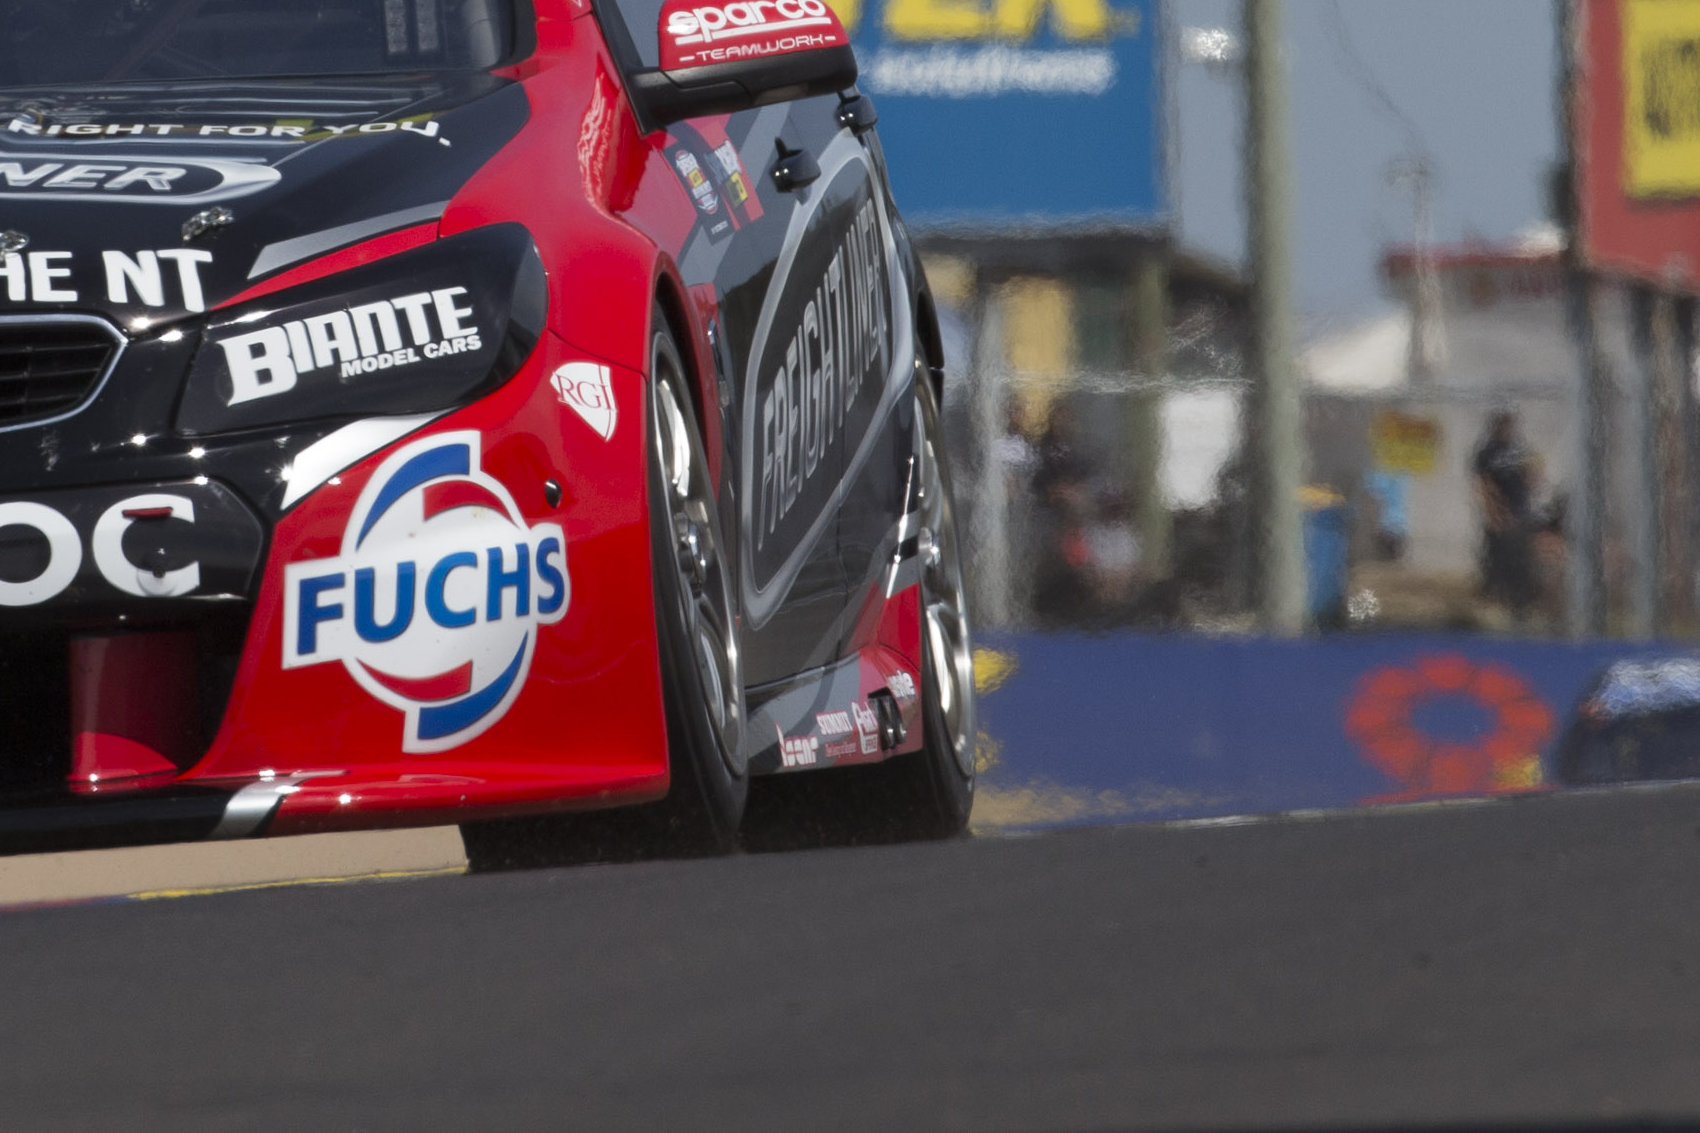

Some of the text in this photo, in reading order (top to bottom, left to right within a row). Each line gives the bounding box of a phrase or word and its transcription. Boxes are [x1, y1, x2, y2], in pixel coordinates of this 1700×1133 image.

[696, 33, 824, 62] TEAMWORK
[7, 118, 186, 136] RIGHT
[199, 124, 306, 138] FOR
[102, 248, 213, 312] NT
[215, 285, 479, 408] BIANTE
[340, 334, 483, 379] MODEL CARS
[554, 372, 615, 412] RGI
[757, 197, 888, 552] FREIGHTLINER
[296, 536, 565, 657] FUCHS
